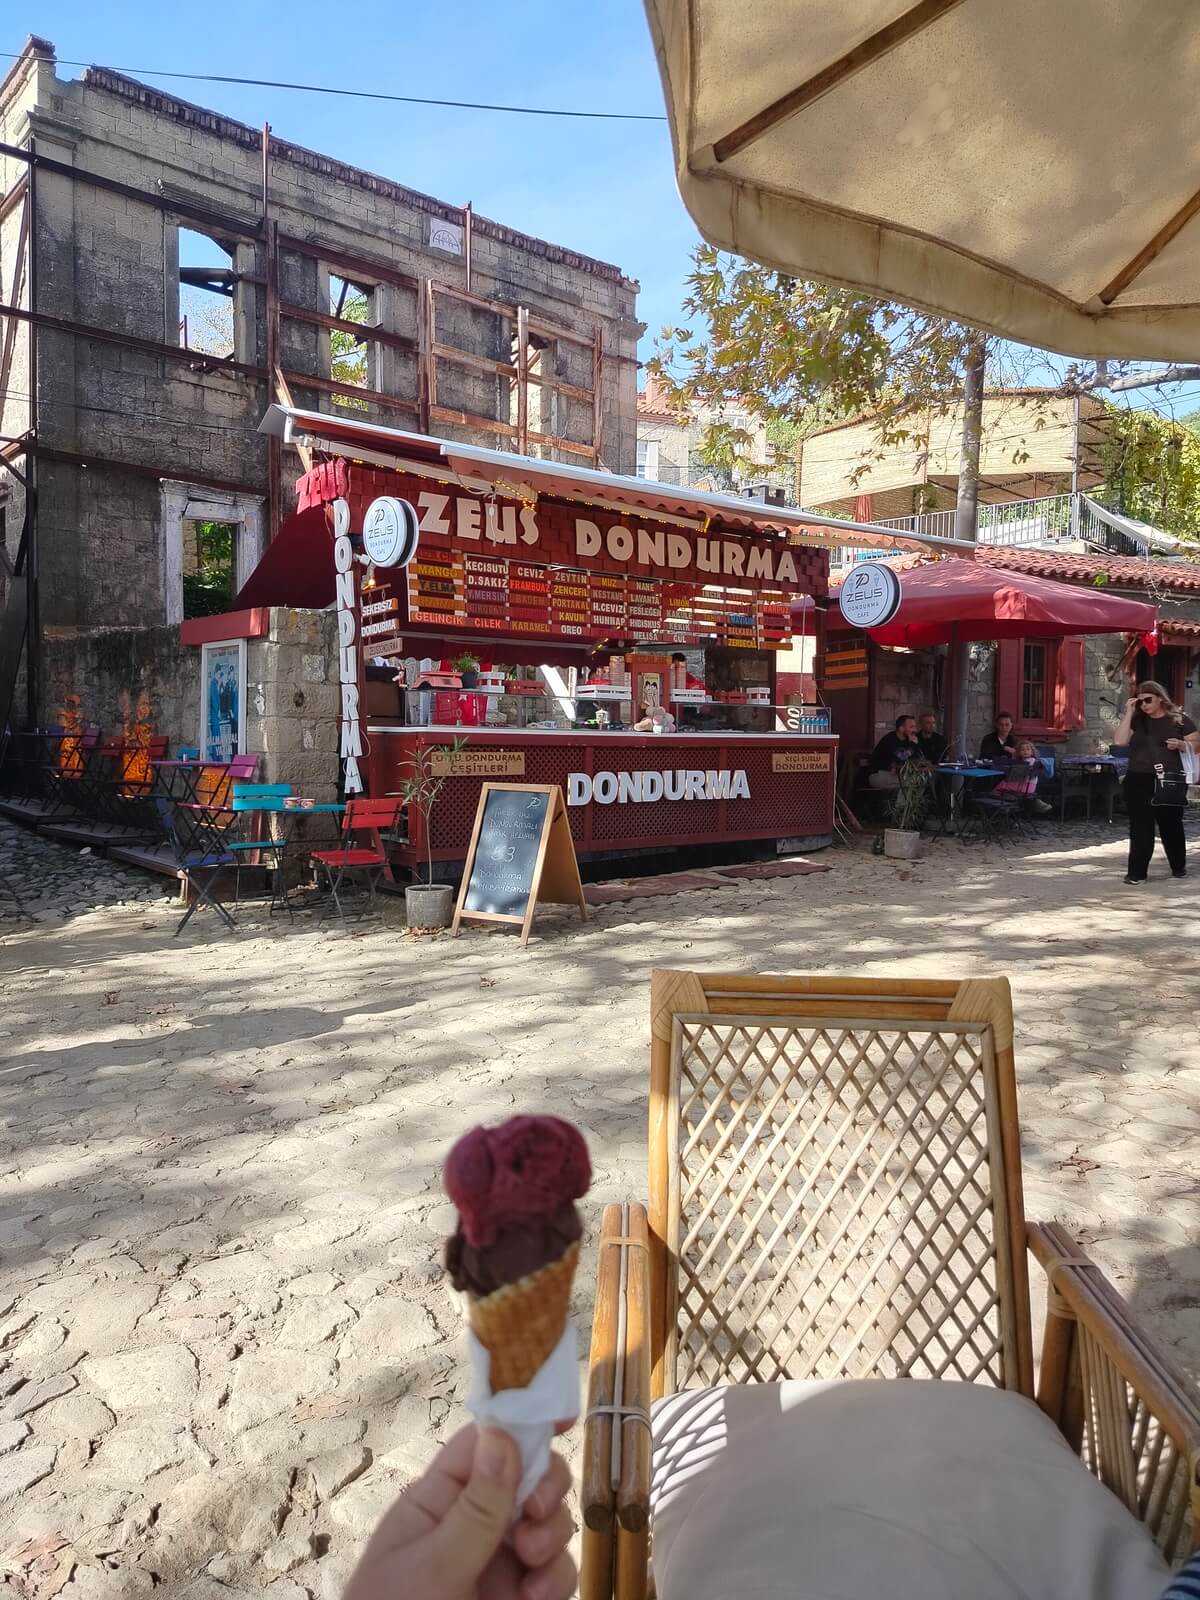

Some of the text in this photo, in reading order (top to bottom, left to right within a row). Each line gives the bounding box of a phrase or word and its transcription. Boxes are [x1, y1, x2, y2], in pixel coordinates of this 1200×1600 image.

[368, 524, 393, 539] ZEUS
[416, 491, 799, 583] ZEUS DONDURMA
[417, 564, 458, 578] MANGO
[510, 579, 551, 593] FRAMBUAZ
[601, 577, 617, 588] MUZ
[845, 587, 884, 603] ZEUS
[552, 597, 590, 611] PORTAKAL
[847, 602, 880, 612] DONDURMA
[560, 611, 585, 623] KAVUN
[511, 620, 550, 633] KARAMEL
[560, 624, 583, 635] OREO
[333, 498, 364, 794] DONDURMA
[466, 753, 522, 763] DONDURMA
[567, 769, 751, 806] DONDURMA
